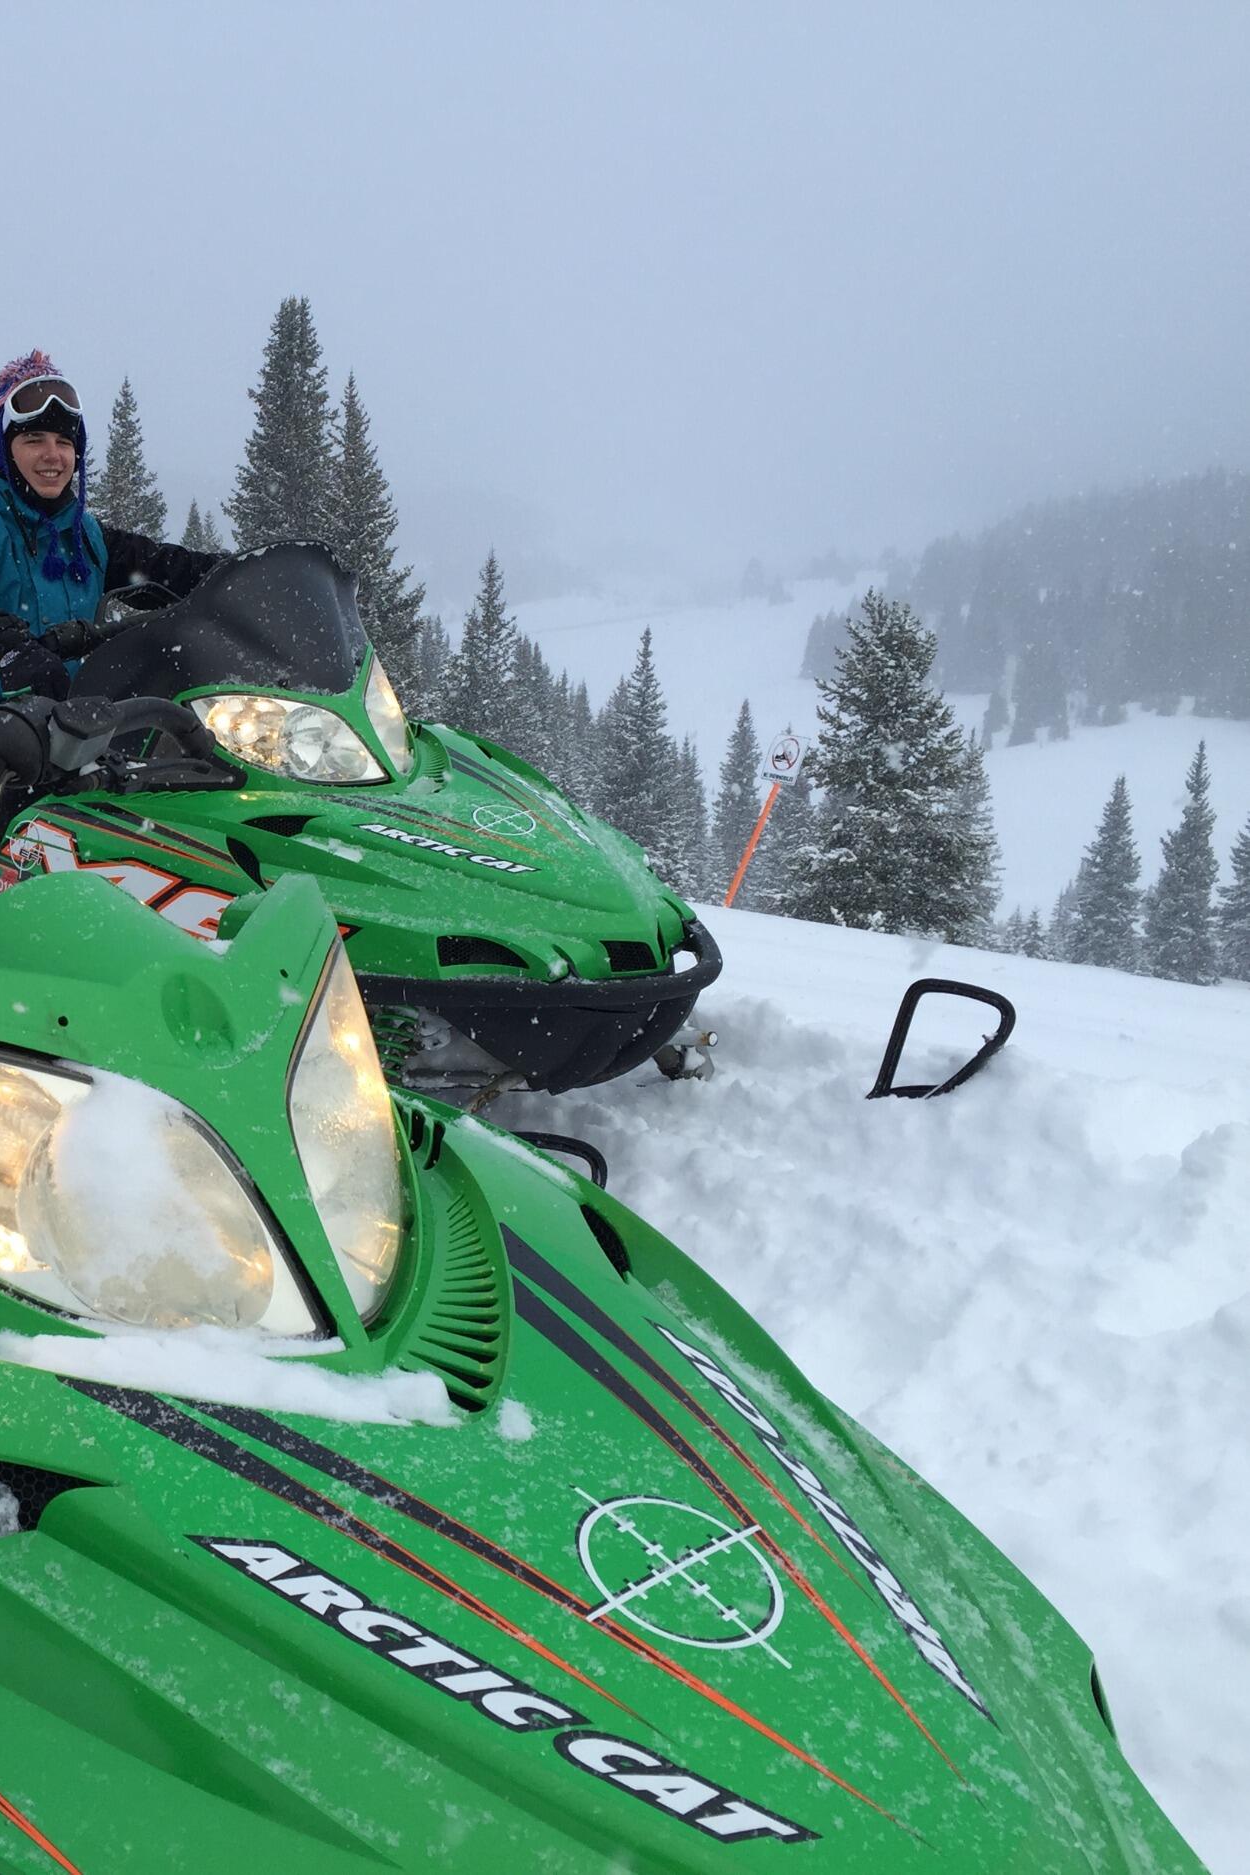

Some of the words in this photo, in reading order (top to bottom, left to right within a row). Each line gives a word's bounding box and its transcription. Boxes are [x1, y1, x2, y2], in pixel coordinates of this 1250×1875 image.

[357, 823, 473, 857] ARCTIC
[467, 854, 540, 874] CAT
[206, 1540, 576, 1729] ARCTIC
[562, 1734, 803, 1839] CAT
